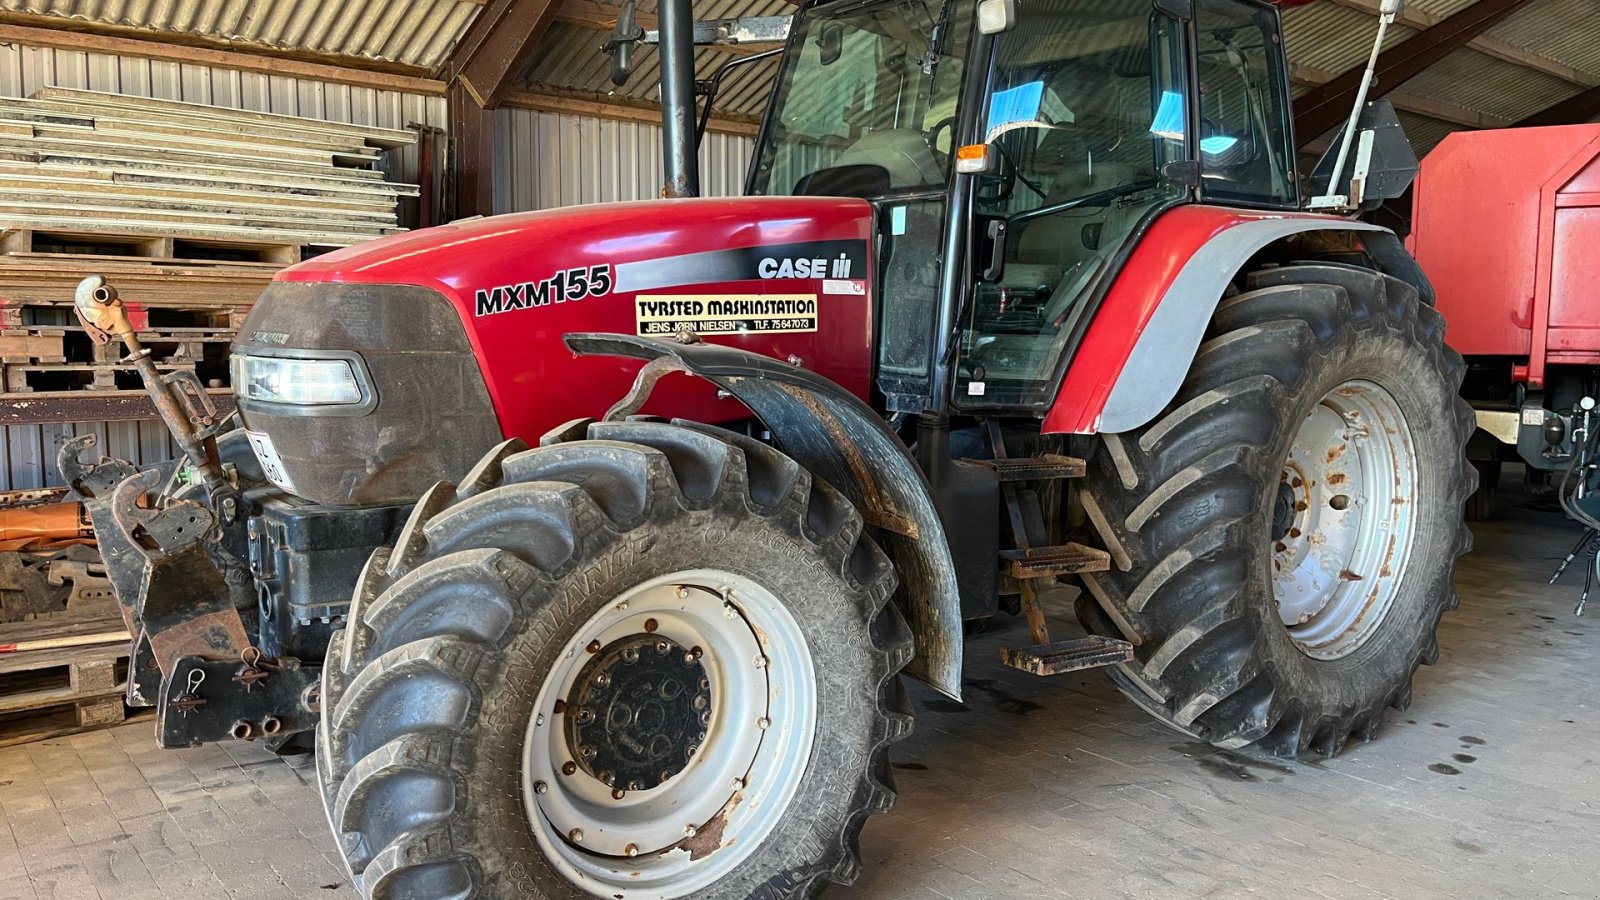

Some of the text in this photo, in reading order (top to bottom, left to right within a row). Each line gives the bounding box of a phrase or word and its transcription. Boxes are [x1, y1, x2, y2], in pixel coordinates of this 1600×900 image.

[476, 265, 611, 316] MXM155
[758, 257, 827, 279] CASE
[638, 299, 815, 317] TYRSTED MASKINSTATION
[645, 321, 671, 333] JENS
[671, 321, 697, 332] JØRN
[699, 320, 736, 332] NIELSEN
[753, 319, 770, 330] TLF.
[752, 527, 851, 616] AGRI-STAR
[505, 533, 655, 699] ALLIANCE
[743, 773, 853, 900] ALLIANC
